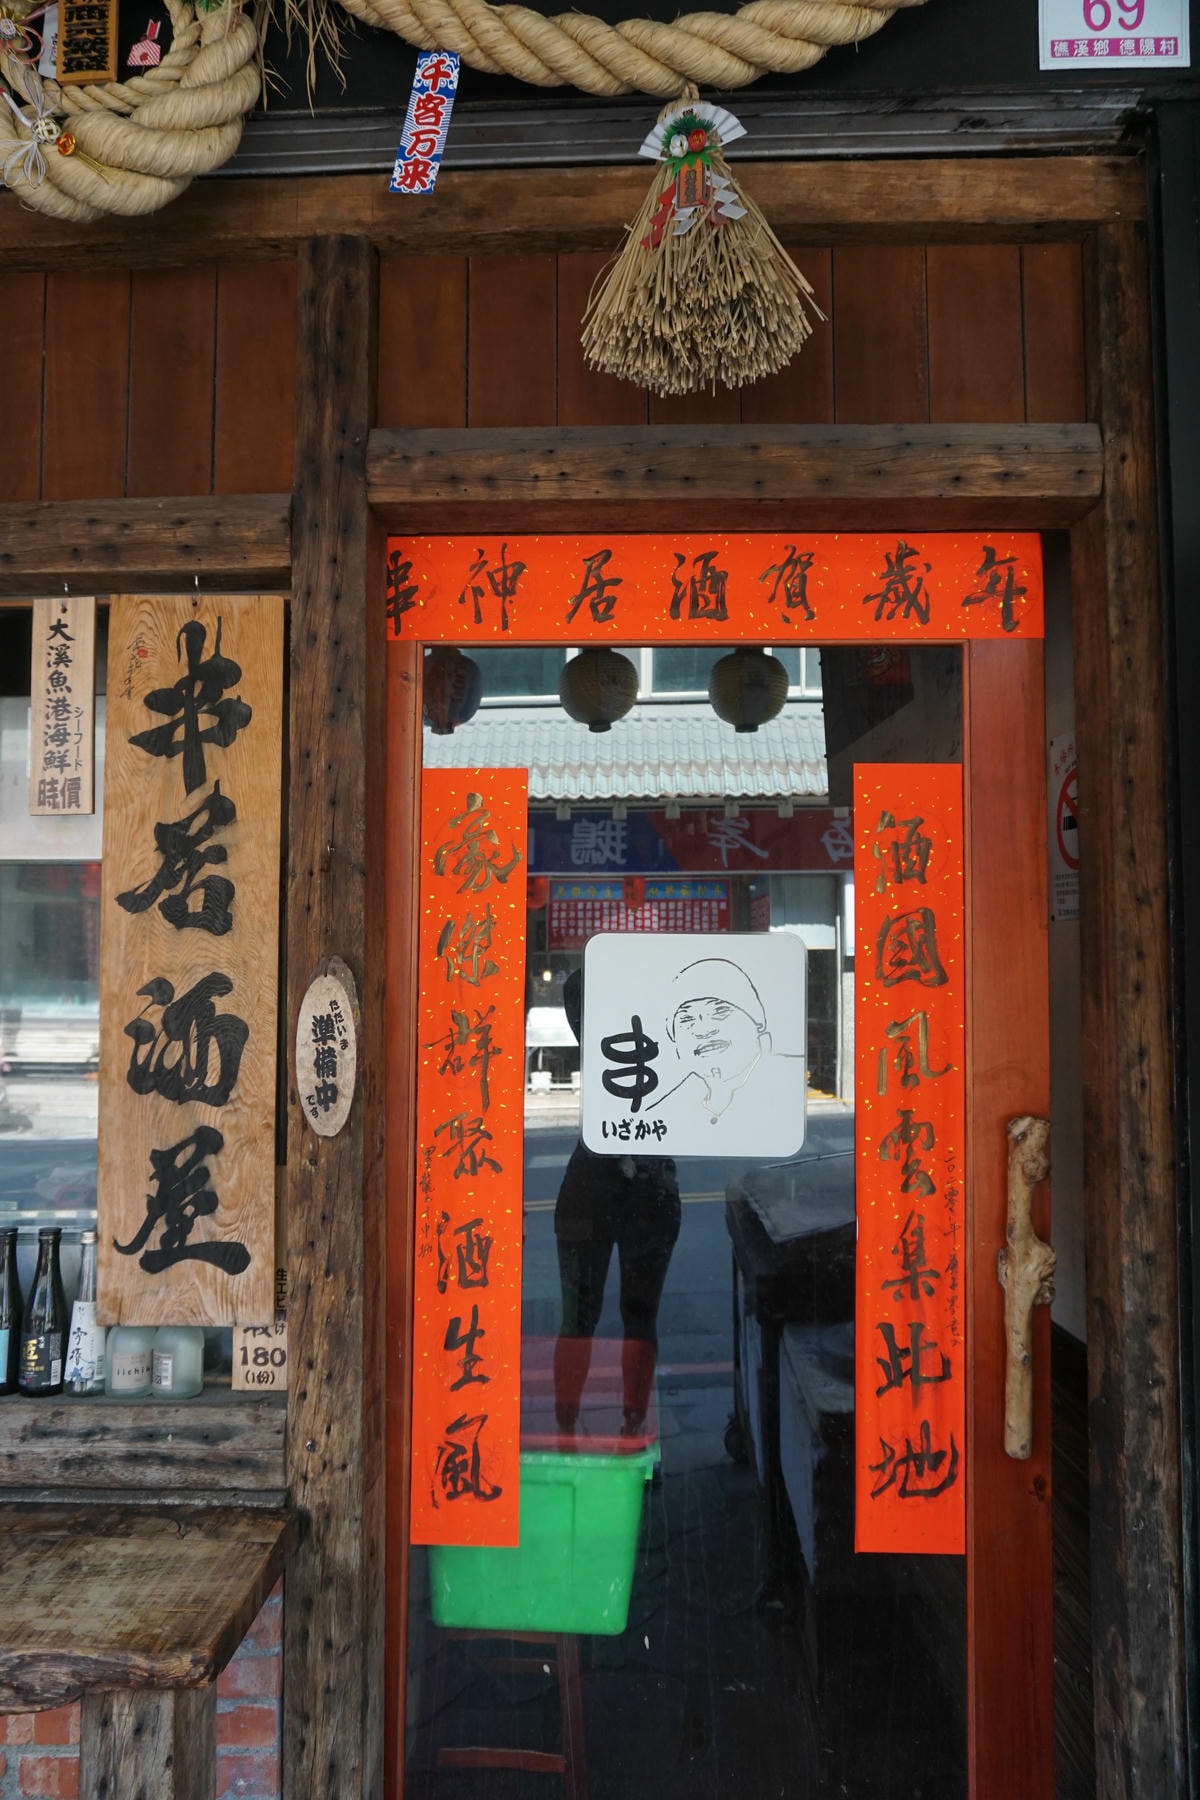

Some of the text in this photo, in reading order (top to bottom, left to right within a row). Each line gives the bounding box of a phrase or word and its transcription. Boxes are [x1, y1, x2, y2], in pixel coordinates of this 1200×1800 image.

[1083, 0, 1145, 31] 69
[1053, 37, 1175, 57] 礁溪鄉 德陽村
[43, 617, 75, 775] 大溪魚港海鮮
[73, 706, 84, 771] シーフード
[37, 777, 82, 809] 時價
[113, 615, 253, 1276] 串居酒屋
[328, 999, 349, 1051] ただいま
[311, 1013, 339, 1113] 準備中
[600, 1014, 660, 1114] 串
[305, 1094, 320, 1120] です
[601, 1118, 668, 1142] いざかや
[239, 1345, 287, 1368] 180
